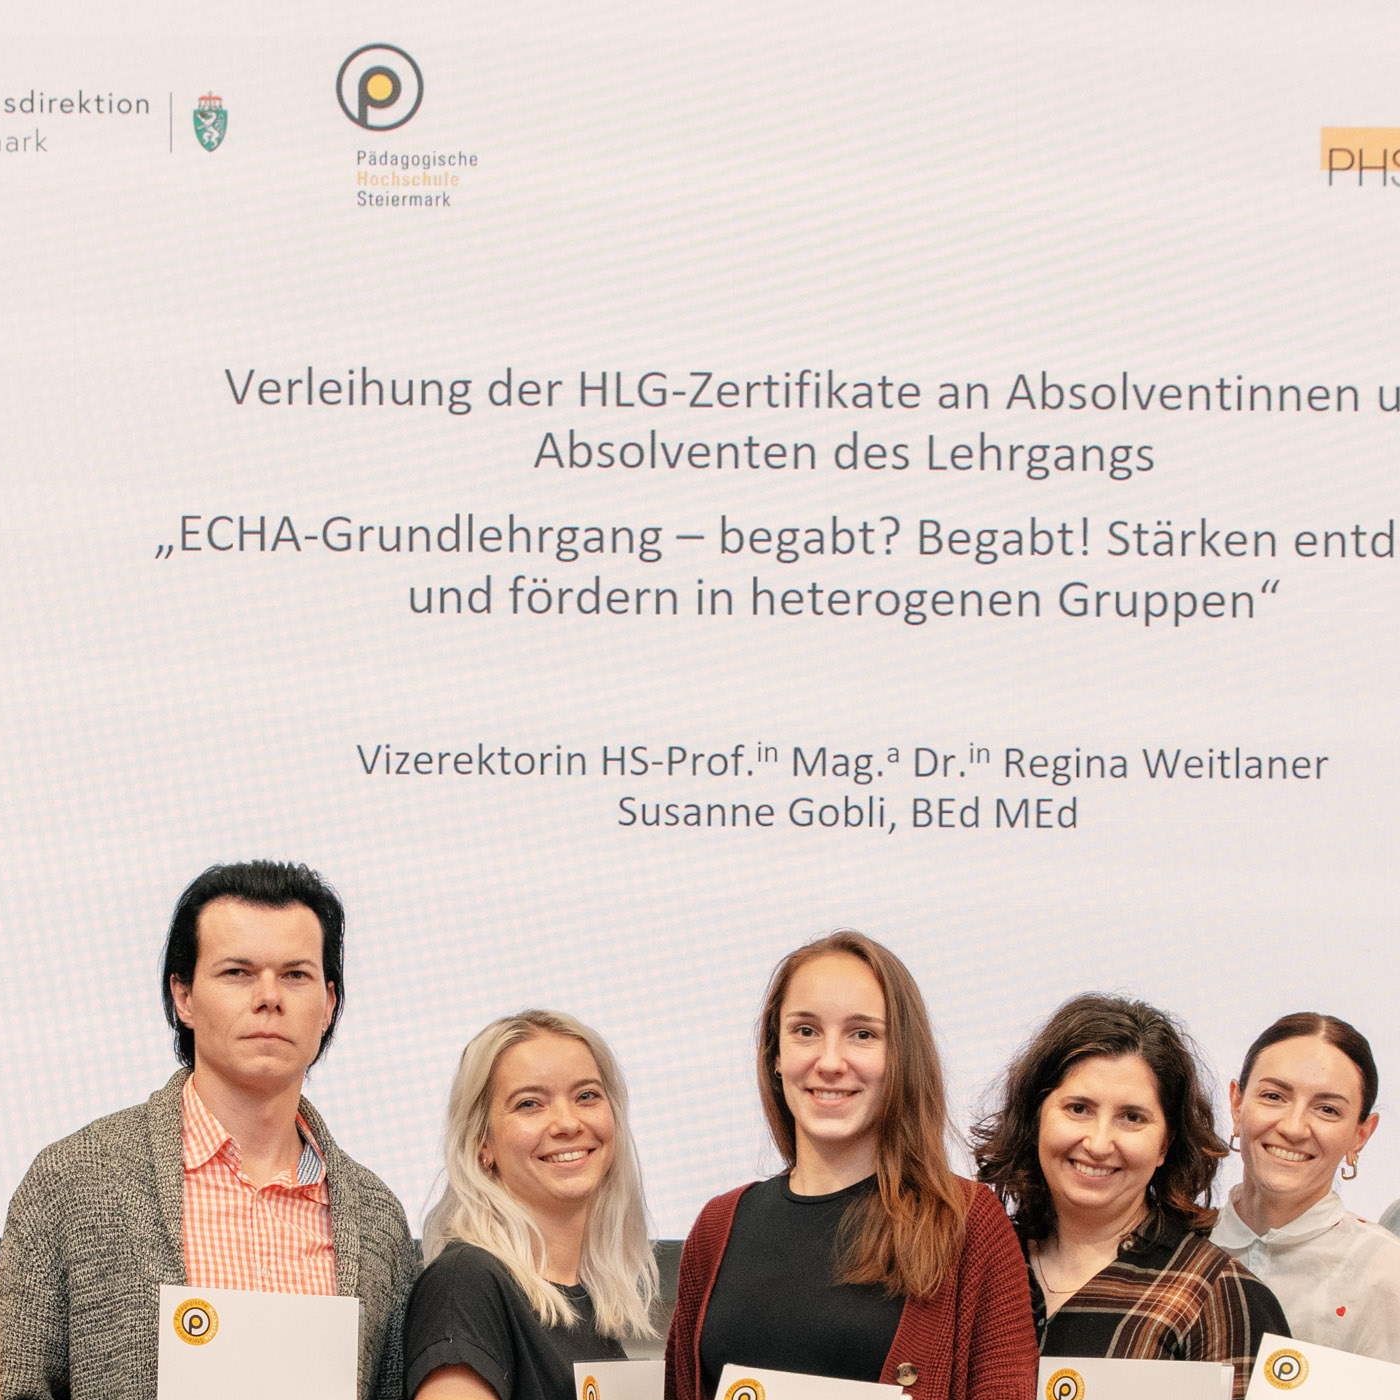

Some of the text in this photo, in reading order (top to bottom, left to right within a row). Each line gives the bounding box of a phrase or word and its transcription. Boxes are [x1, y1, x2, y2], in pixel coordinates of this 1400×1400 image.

[356, 149, 478, 169] Pädagogische
[357, 170, 460, 187] Hochschule
[356, 190, 451, 208] Steiermark
[224, 365, 473, 416] Verleihung
[488, 366, 563, 407] der
[580, 368, 921, 409] HLG-Zertifikate
[938, 382, 989, 410] an
[1005, 370, 1359, 412] Absolventinnen
[533, 428, 1155, 481] Absolventen des Lehrgangs
[154, 513, 663, 564] „ECHA-Grundlehrgang
[720, 514, 901, 564] begabt?
[919, 516, 1089, 566] Begabt!
[1107, 517, 1277, 558] Stärken
[409, 574, 492, 615] und
[508, 574, 678, 616] fördern
[697, 578, 733, 616] in
[752, 575, 1041, 626] heterogenen
[356, 742, 587, 776] Vizerektorin
[1005, 747, 1128, 787] Regina
[1142, 746, 1330, 780] Weitlaner
[618, 794, 1077, 835] Susanne Gobli, BEd MEd
